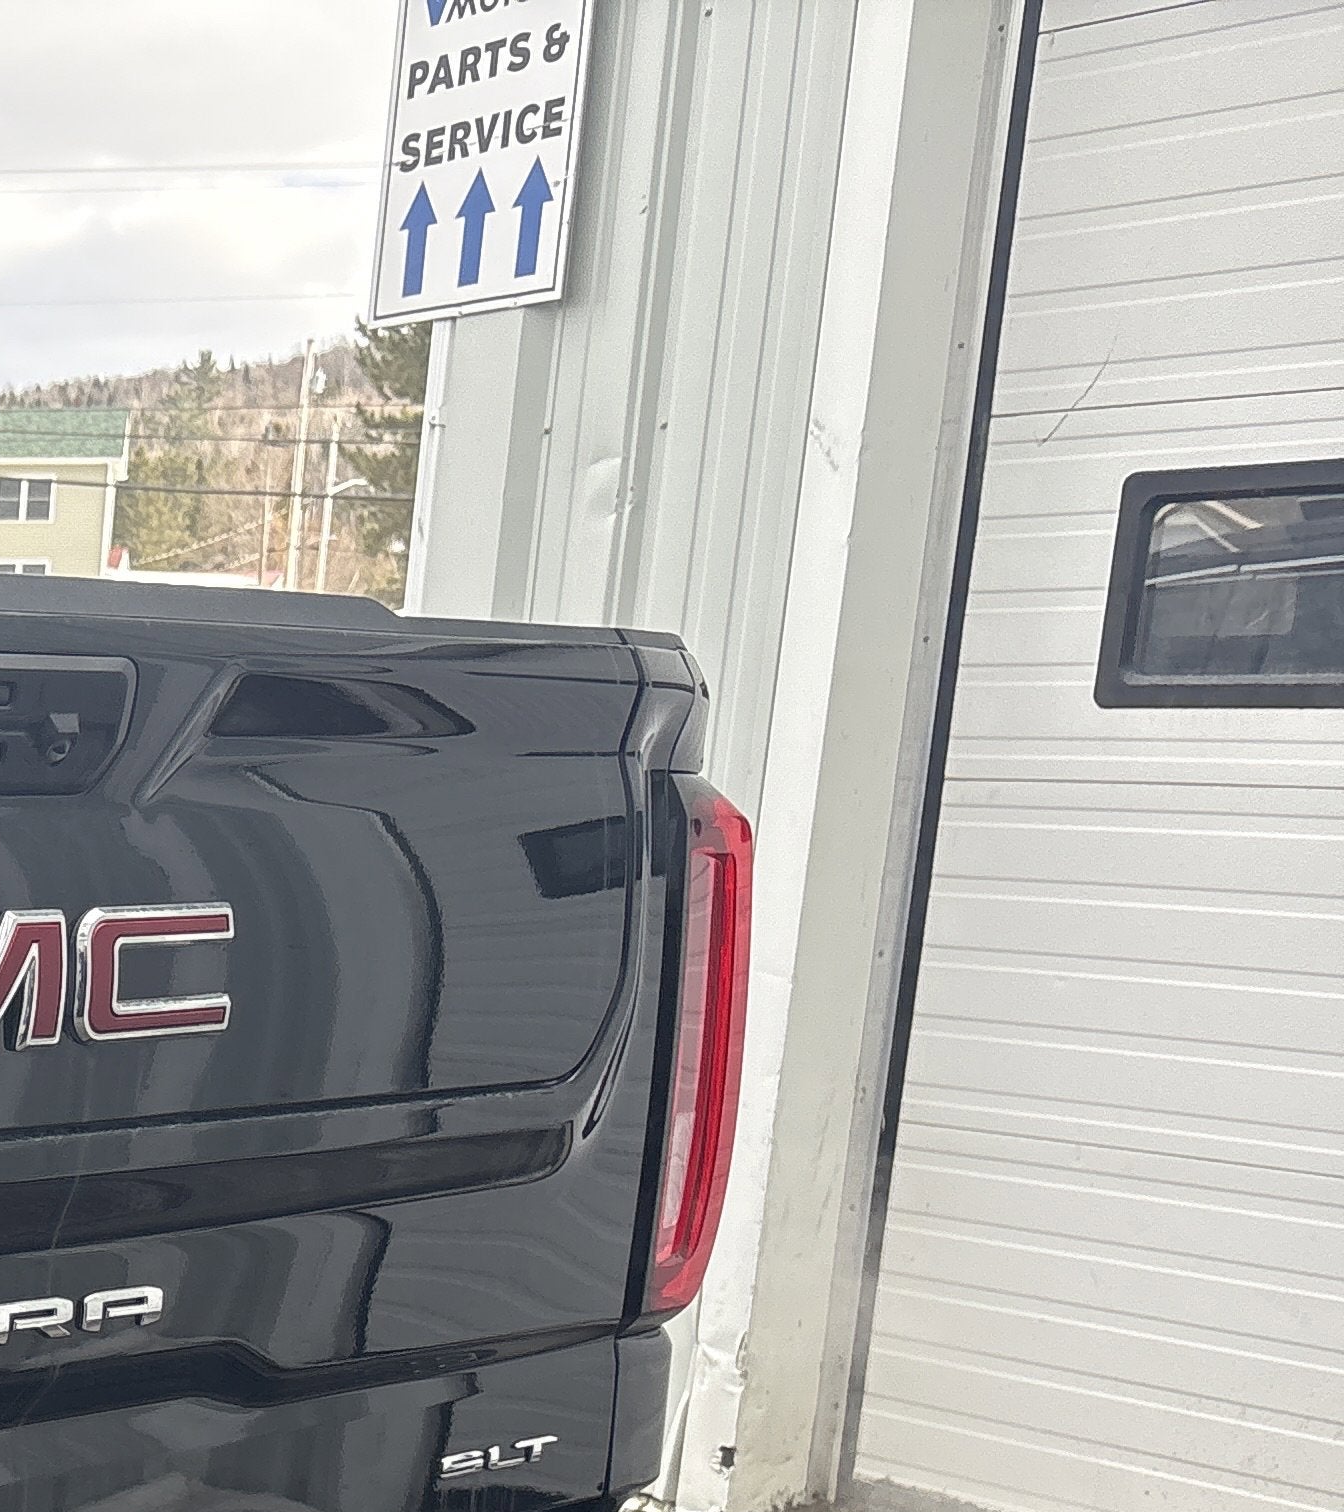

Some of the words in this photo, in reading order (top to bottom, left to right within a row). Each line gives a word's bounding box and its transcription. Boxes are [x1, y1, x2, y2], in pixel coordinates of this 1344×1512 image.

[406, 32, 531, 100] PARTS
[542, 22, 570, 63] &
[399, 96, 566, 173] SERVICE
[439, 1434, 559, 1479] SLT
